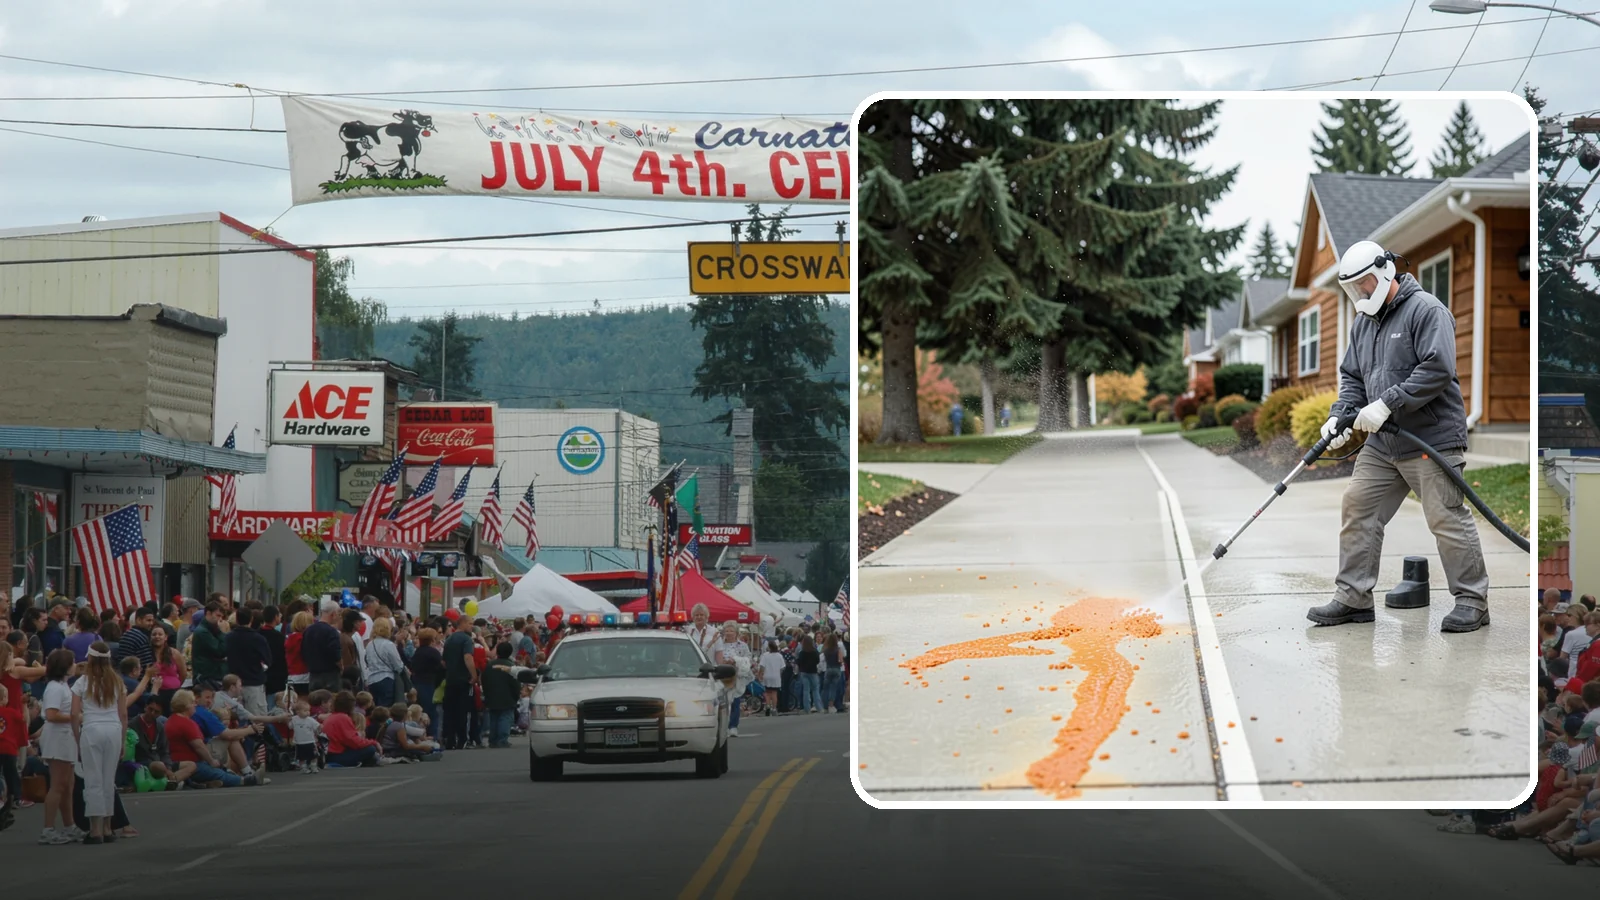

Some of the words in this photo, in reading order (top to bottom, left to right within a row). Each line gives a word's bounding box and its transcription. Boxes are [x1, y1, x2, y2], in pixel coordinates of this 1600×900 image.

[481, 141, 605, 192] JULY
[632, 150, 746, 197] 4th.
[697, 254, 850, 280] CROSSWA
[283, 380, 373, 420] ACE
[405, 409, 453, 422] CEDAR
[461, 409, 485, 422] LOG
[283, 421, 371, 437] Hardware
[95, 485, 124, 495] Vincent
[126, 486, 136, 495] de
[138, 486, 155, 495] Paul
[688, 526, 741, 535] CRNATION
[699, 535, 730, 543] GLASS
